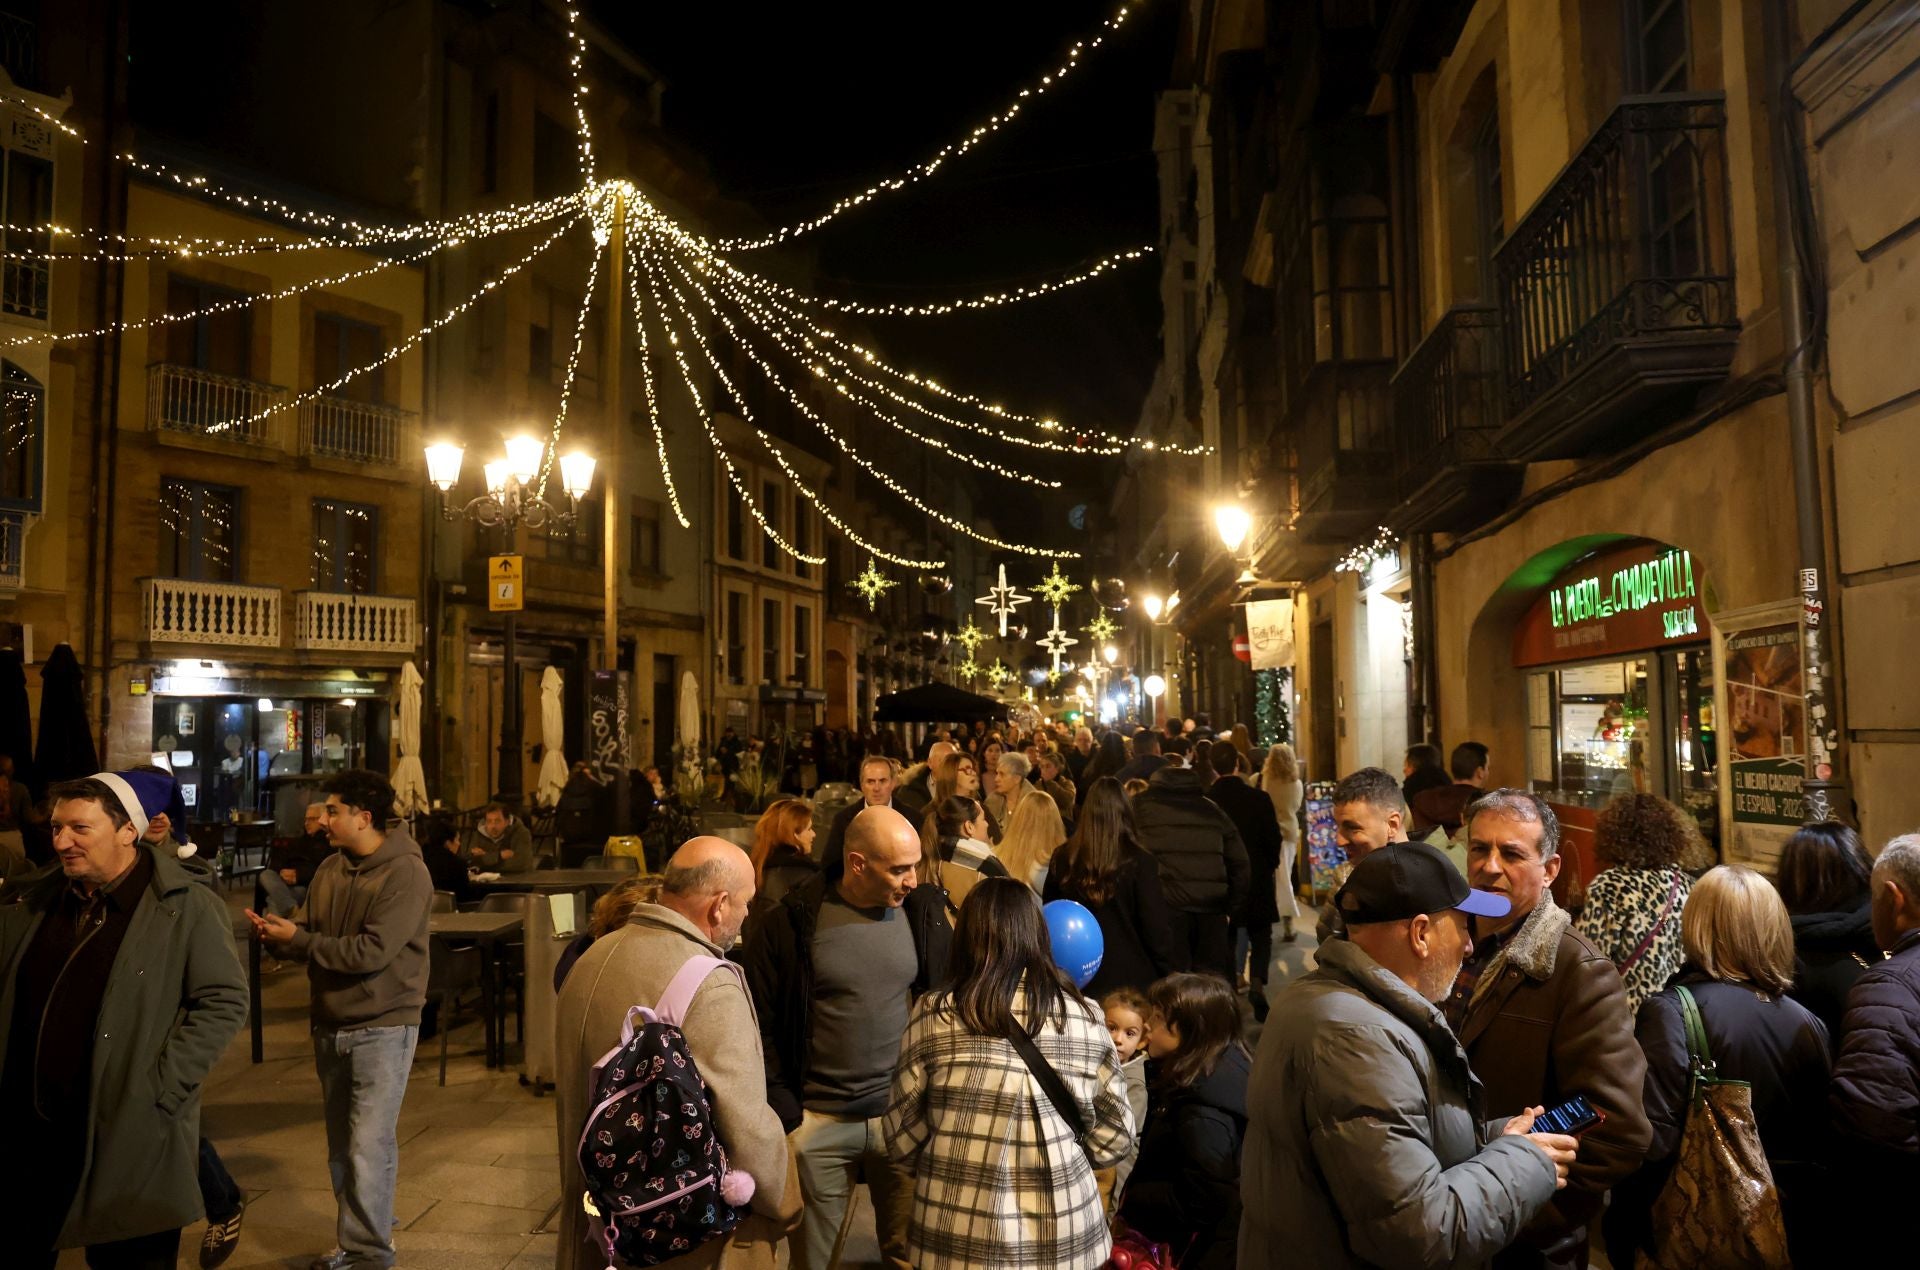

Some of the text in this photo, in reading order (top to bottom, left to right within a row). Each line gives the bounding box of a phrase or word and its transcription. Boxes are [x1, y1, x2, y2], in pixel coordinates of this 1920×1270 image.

[1550, 590, 1565, 628] LA
[1565, 577, 1601, 625] PUERTA
[1612, 549, 1696, 613] CIMADEVILLA
[1735, 771, 1744, 789] EL
[1744, 772, 1769, 790] MEJOR
[1736, 793, 1746, 812] DE
[1746, 793, 1777, 815] ESPAÑA
